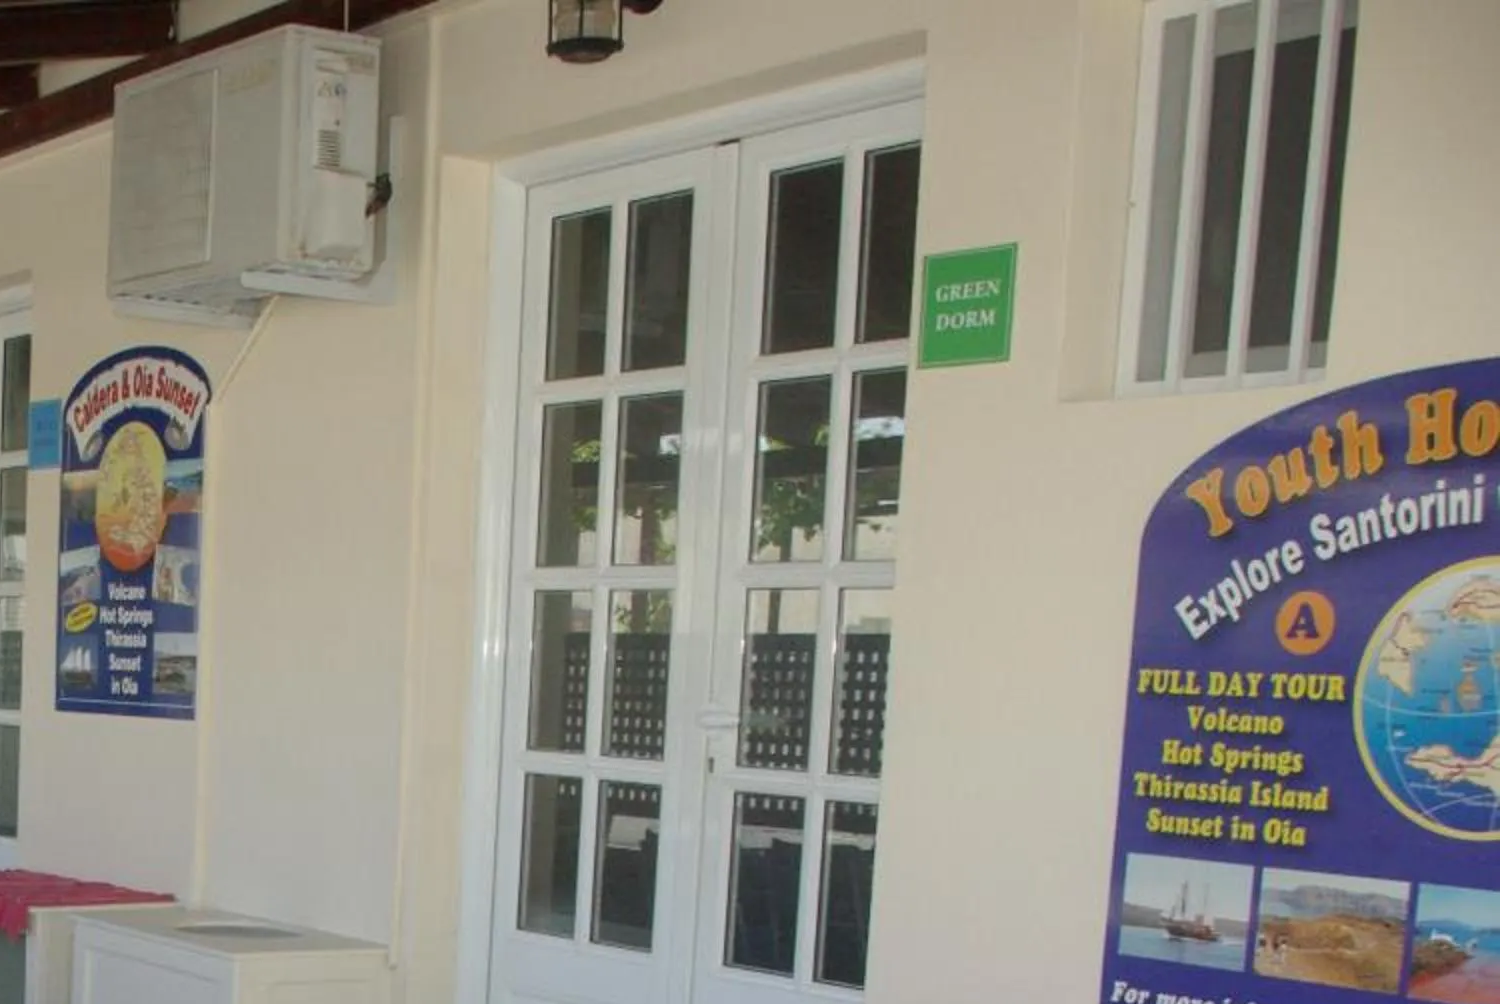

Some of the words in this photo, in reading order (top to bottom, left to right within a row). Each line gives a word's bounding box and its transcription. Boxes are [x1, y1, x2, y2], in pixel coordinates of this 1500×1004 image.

[935, 279, 1001, 302] GREEN
[935, 309, 996, 332] DORM
[74, 380, 119, 432] Caldera
[121, 369, 130, 400] &
[133, 365, 153, 397] Oia
[156, 366, 201, 418] Sunset
[1185, 410, 1384, 537] Youth
[1405, 387, 1500, 465] Ho
[1173, 539, 1304, 640] Explore
[1310, 474, 1486, 561] Santorini
[1286, 602, 1320, 639] A
[1137, 669, 1201, 696] FULL
[1208, 671, 1264, 699] DAY
[1270, 673, 1346, 701] TOUR
[1187, 705, 1284, 736] Volcano
[1161, 739, 1203, 767] Hot
[1208, 741, 1304, 776] Springs
[1133, 772, 1241, 805] Thirassia
[1250, 780, 1329, 812] Island
[1146, 809, 1224, 839] Sunset
[1230, 815, 1256, 842] in
[1263, 818, 1307, 846] Oia
